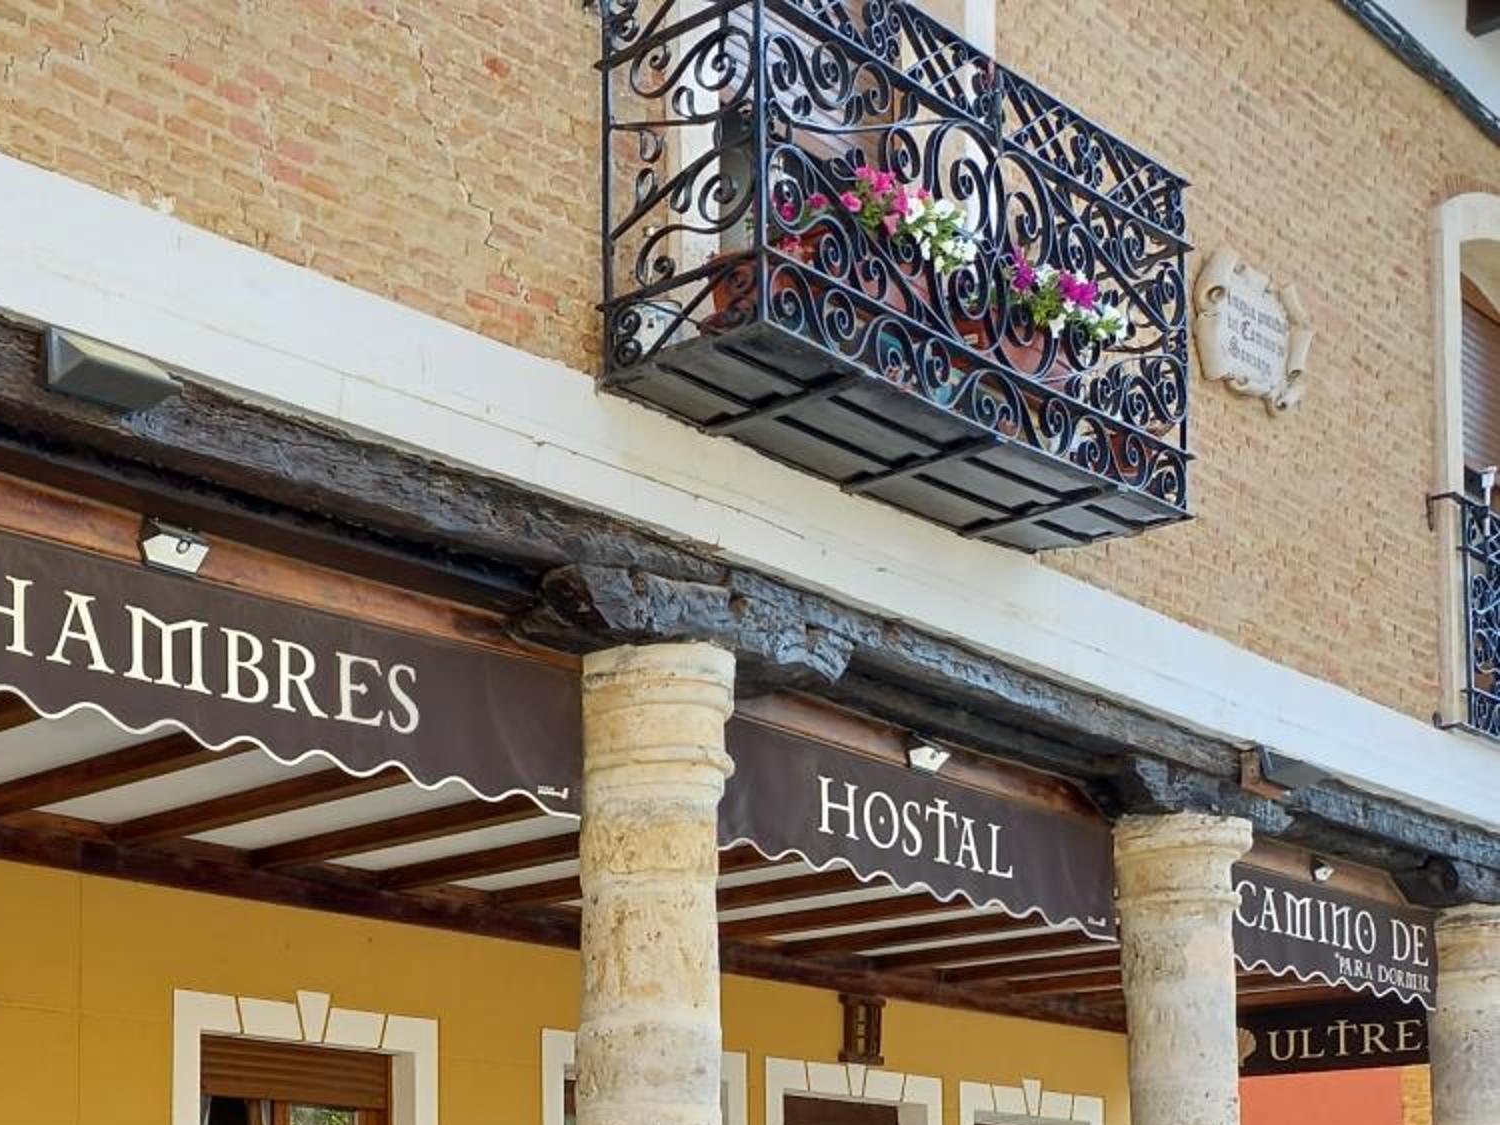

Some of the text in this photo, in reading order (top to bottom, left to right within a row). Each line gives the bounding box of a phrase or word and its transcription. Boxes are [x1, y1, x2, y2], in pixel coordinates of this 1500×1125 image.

[817, 775, 1013, 879] HOSTAL
[1235, 879, 1430, 967] CAMINO DE
[1268, 1019, 1428, 1062] ULTRE
